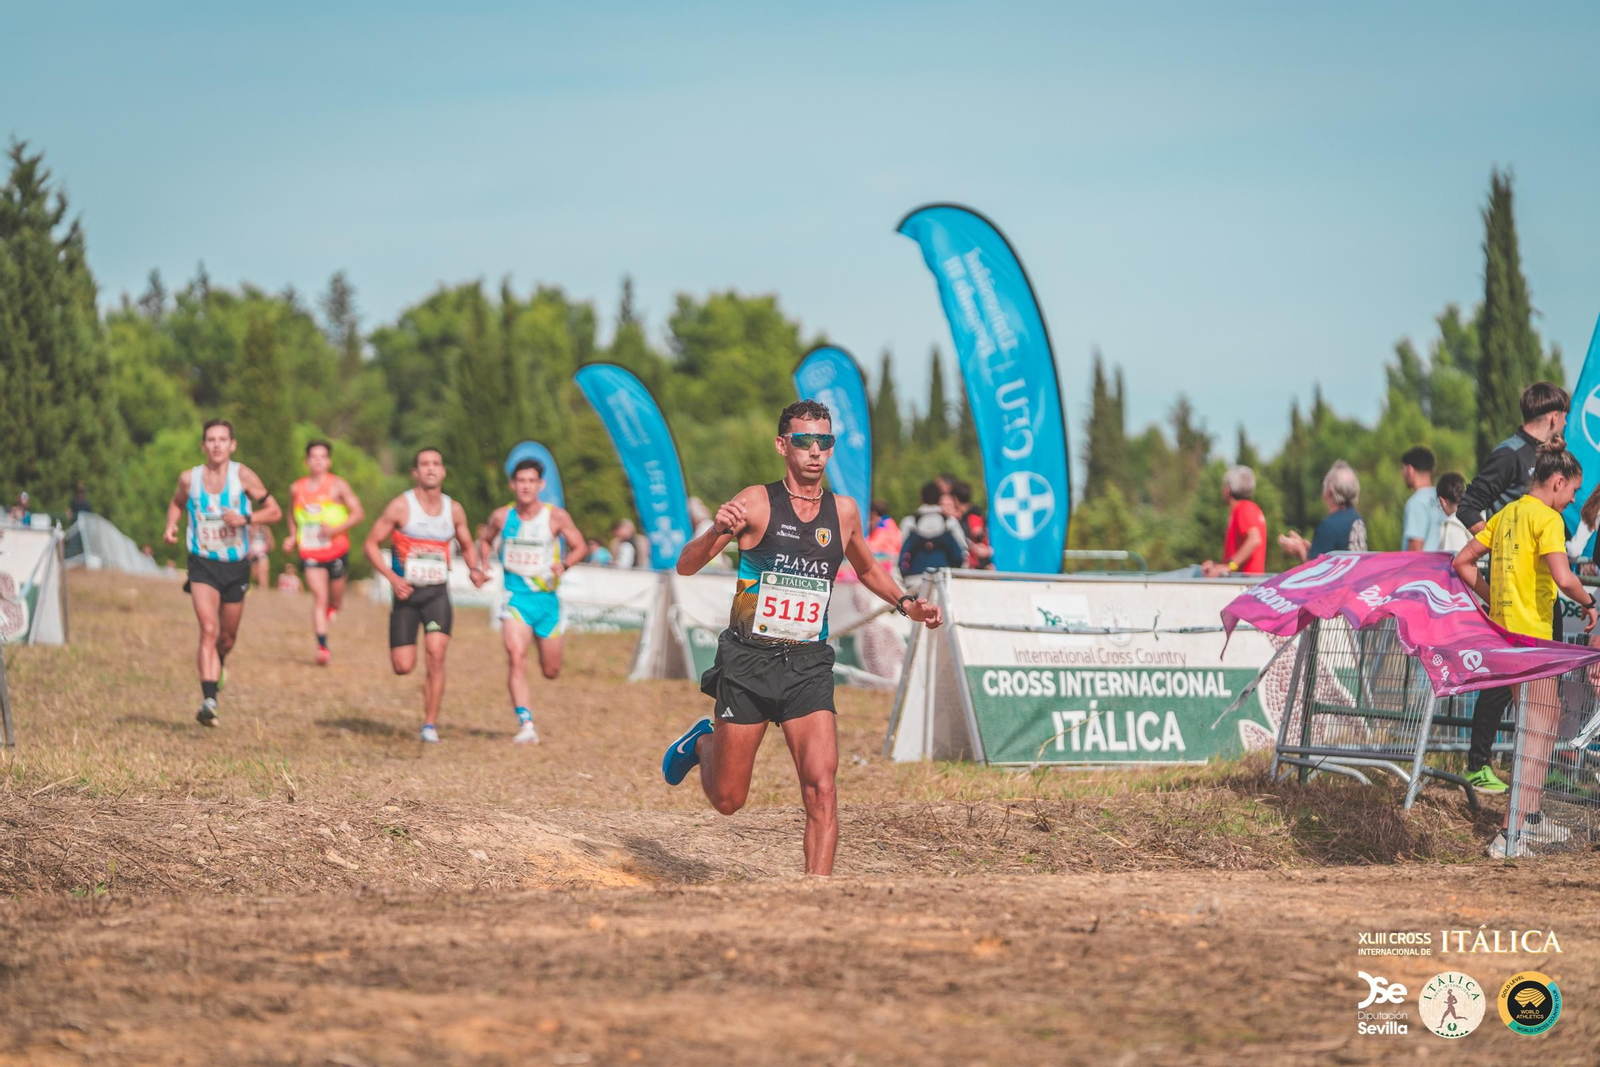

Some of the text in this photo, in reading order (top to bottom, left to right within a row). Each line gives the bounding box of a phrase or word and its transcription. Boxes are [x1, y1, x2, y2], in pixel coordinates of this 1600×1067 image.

[774, 553, 829, 575] PLAYAS
[762, 596, 820, 623] 5113
[1013, 647, 1187, 668] International Cross Country
[982, 670, 1232, 698] CROSS INTERNACIONAL
[1052, 700, 1186, 752] ITÁLICA
